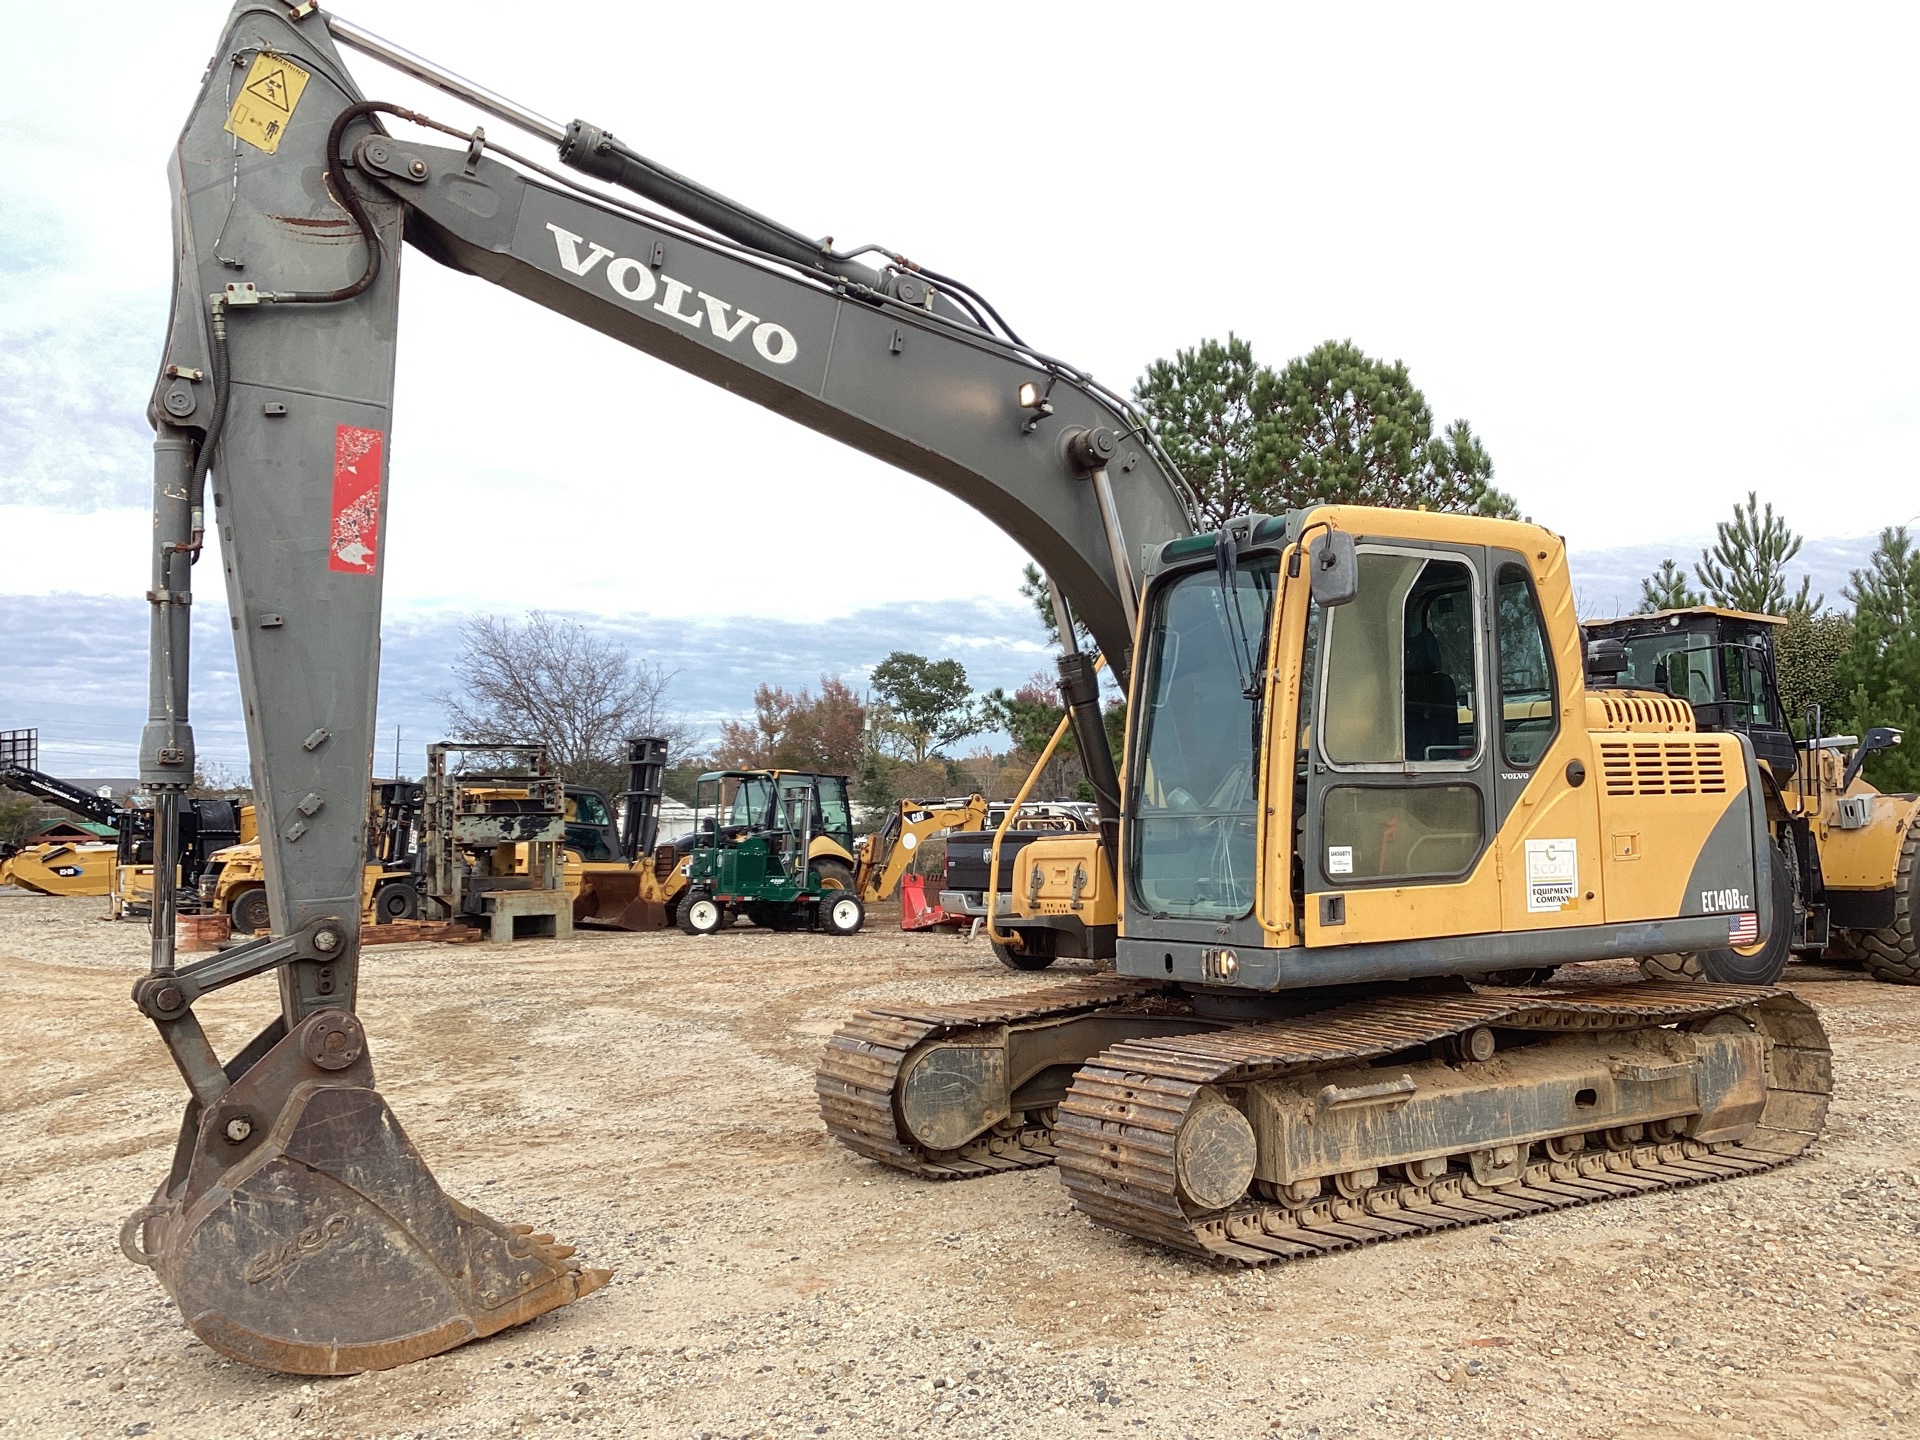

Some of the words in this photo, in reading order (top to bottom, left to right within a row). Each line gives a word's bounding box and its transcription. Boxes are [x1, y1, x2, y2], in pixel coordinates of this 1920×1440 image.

[270, 53, 307, 78] WARNING
[546, 222, 798, 364] VOLVO
[1501, 772, 1530, 780] VOLVO
[911, 811, 925, 823] CAT
[1532, 887, 1573, 897] EQUIPMENT
[1536, 895, 1571, 904] COMPANY
